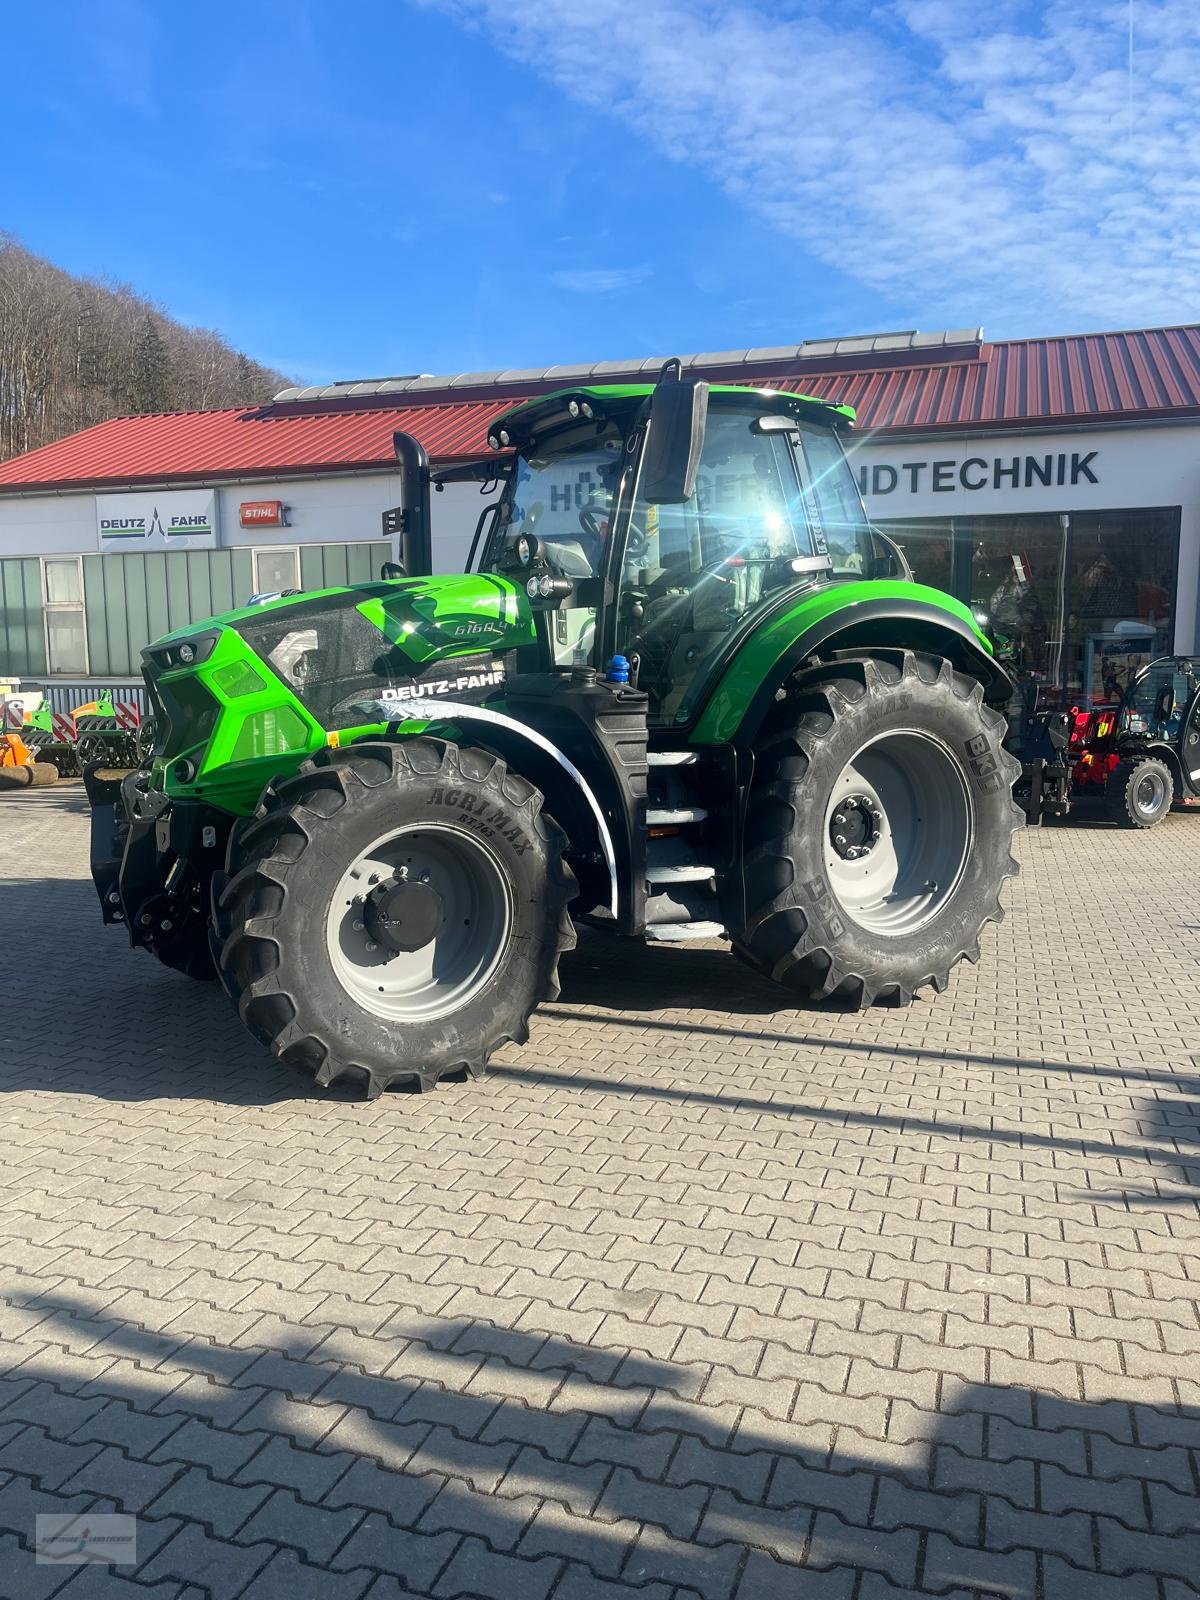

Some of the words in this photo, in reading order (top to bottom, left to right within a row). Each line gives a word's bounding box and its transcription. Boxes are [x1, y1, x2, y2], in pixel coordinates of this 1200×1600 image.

[857, 451, 1099, 496] NDTECHNIK
[100, 518, 146, 529] DEUTZ
[171, 515, 207, 526] FAHR
[244, 508, 275, 518] STIHL
[381, 671, 507, 701] DEUTZ-FAHR
[965, 734, 1001, 795] BKT
[803, 875, 847, 941] BKT
